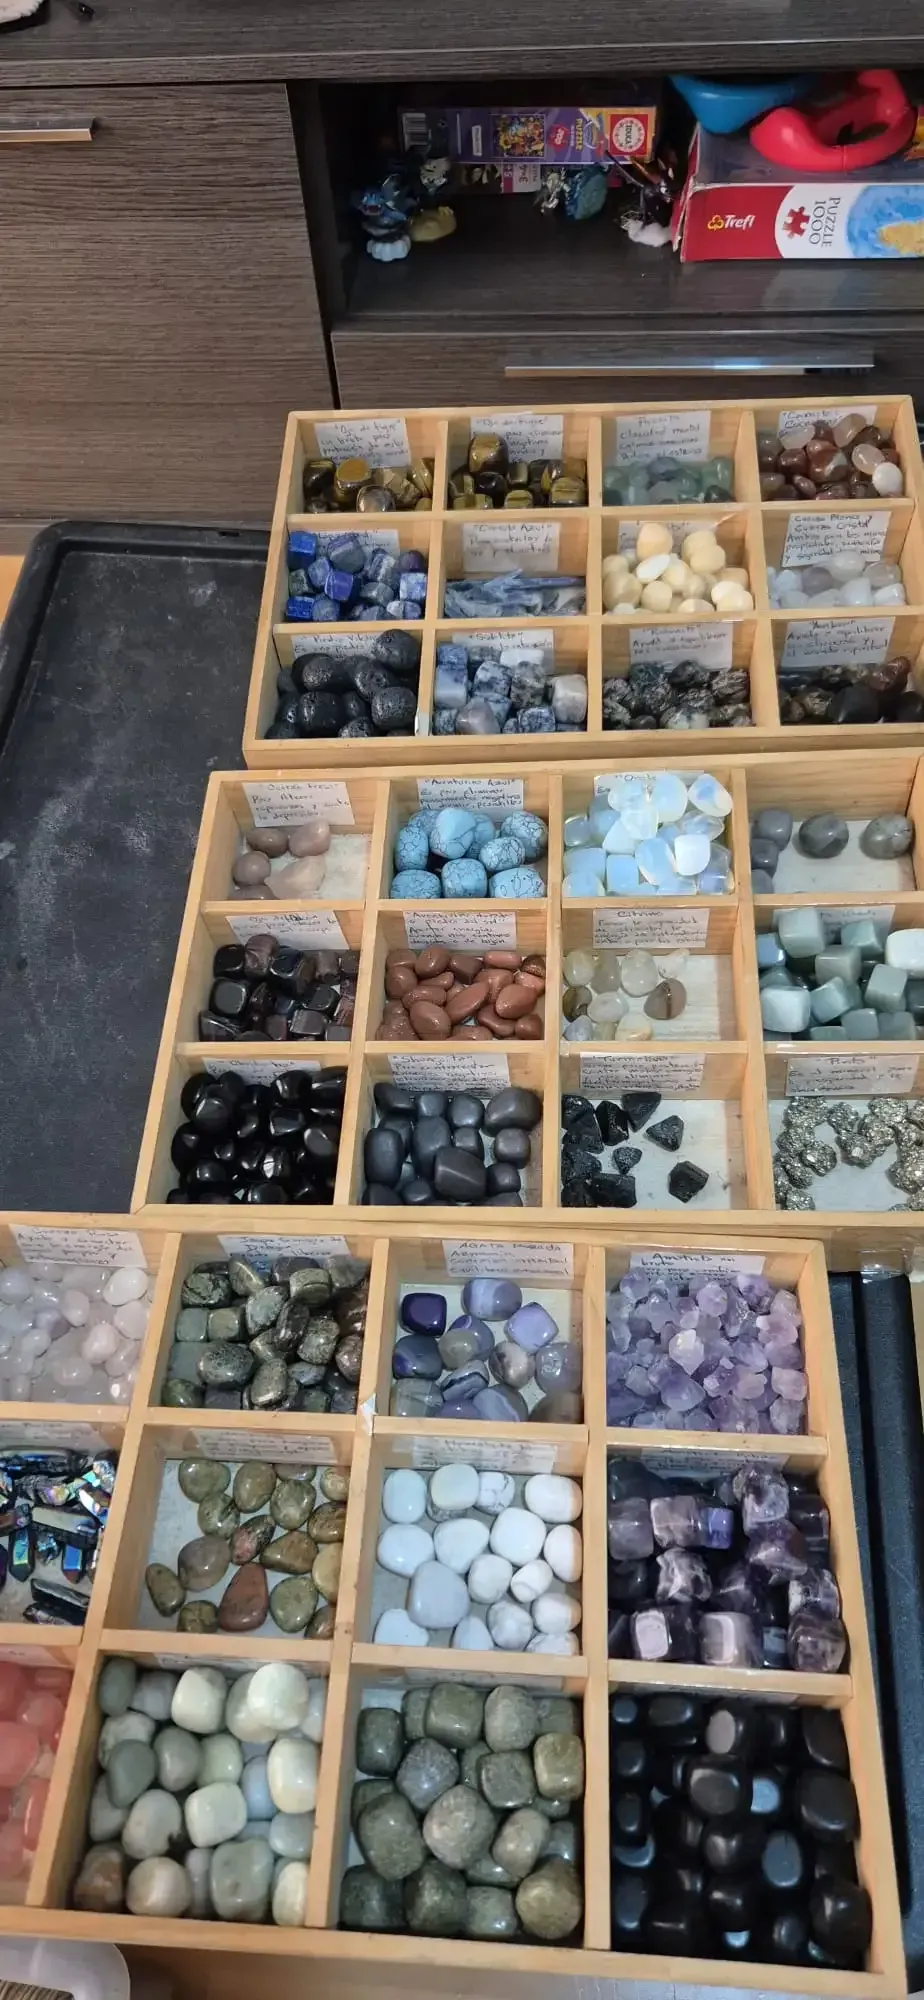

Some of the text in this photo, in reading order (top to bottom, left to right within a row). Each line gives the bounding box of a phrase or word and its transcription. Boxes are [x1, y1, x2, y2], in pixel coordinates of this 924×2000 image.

[724, 214, 757, 231] Trefl
[808, 200, 827, 245] 1000
[820, 195, 841, 248] PUZZLE
